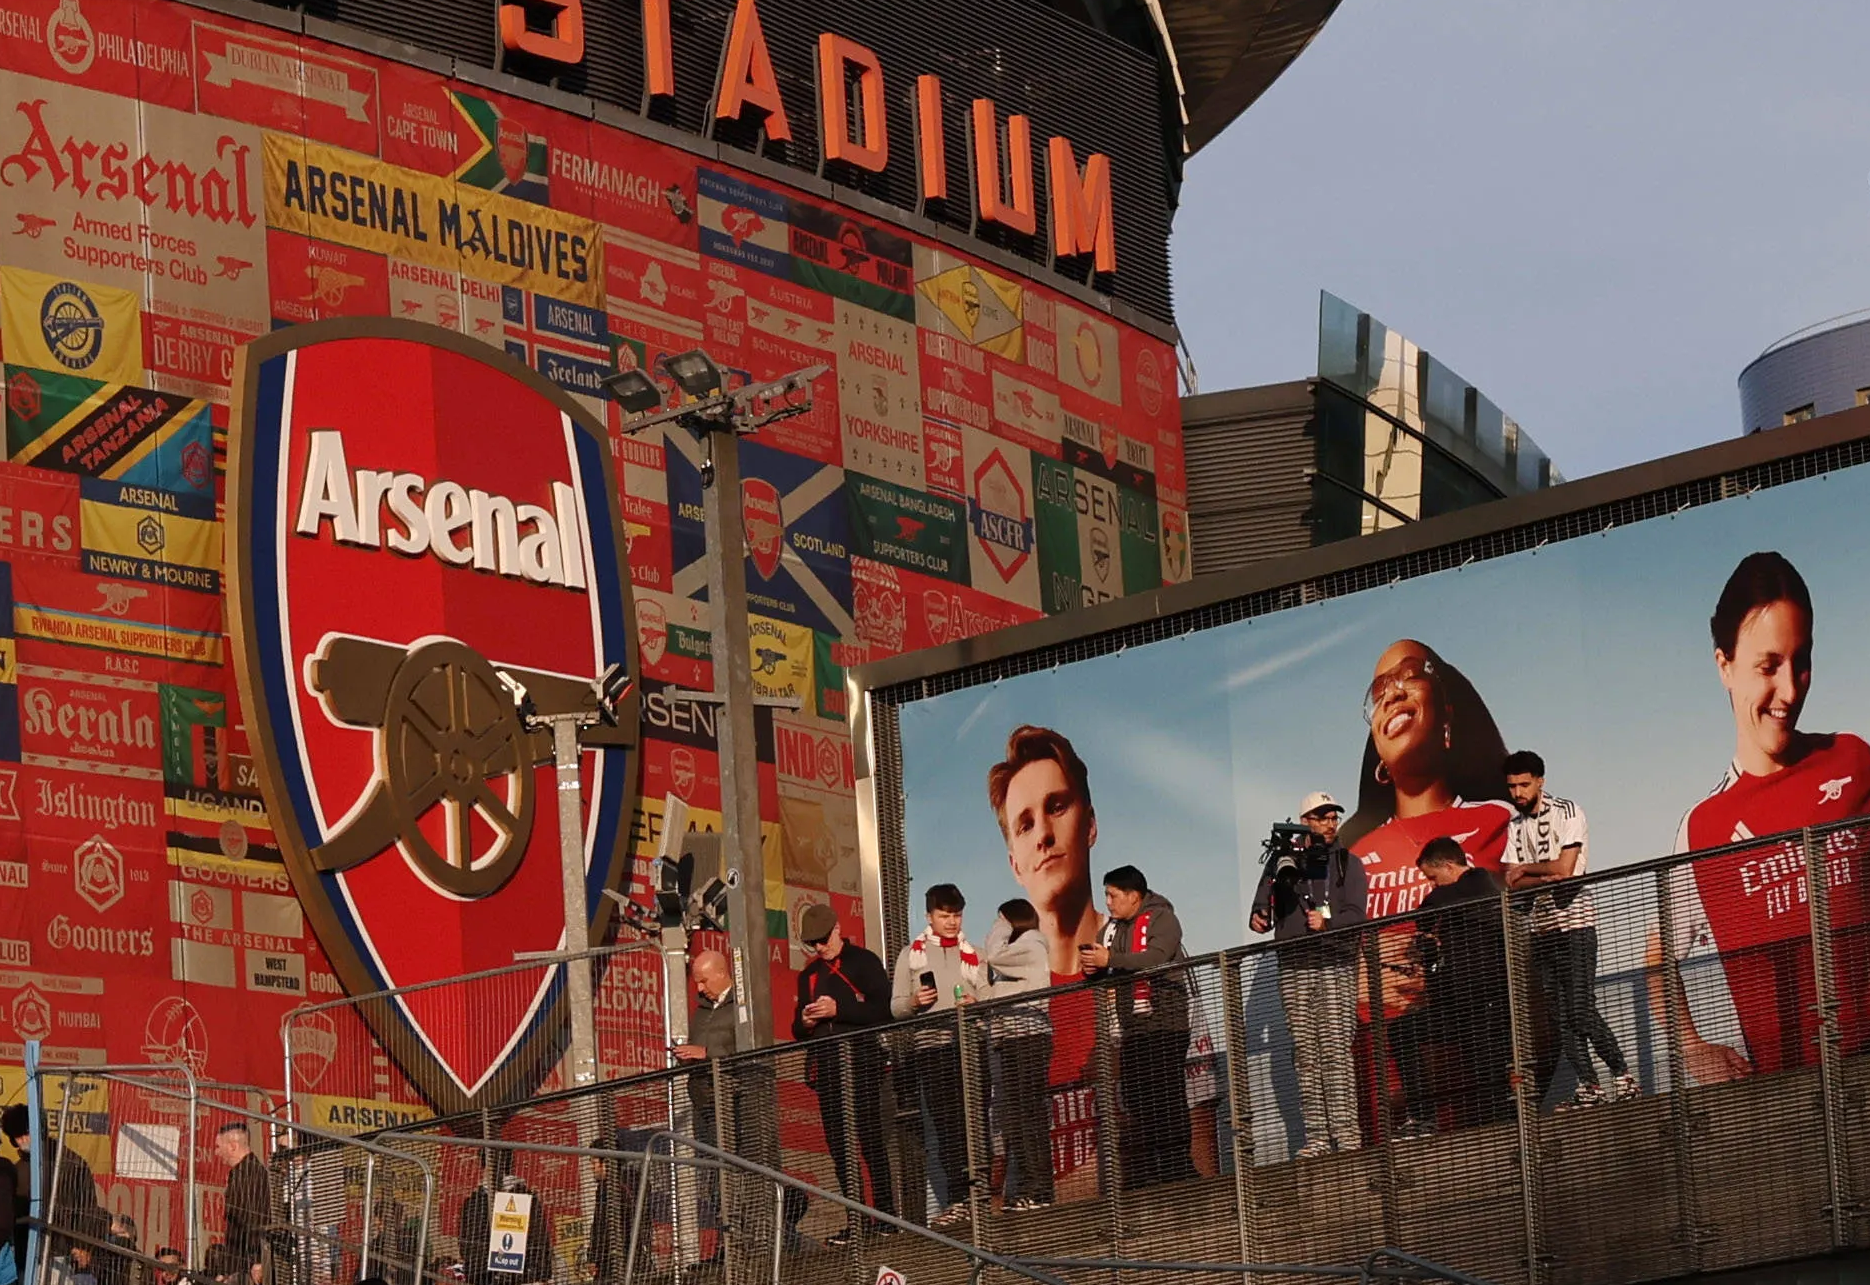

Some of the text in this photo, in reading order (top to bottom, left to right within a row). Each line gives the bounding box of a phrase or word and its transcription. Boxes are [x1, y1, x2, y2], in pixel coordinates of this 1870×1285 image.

[97, 27, 189, 77] PHILADELPHIA
[231, 46, 346, 93] DUBLIN ARSENAL
[402, 102, 440, 125] ARSENAL
[387, 116, 459, 154] CAPE TOWN
[0, 98, 257, 229] Arsenal
[552, 150, 659, 207] FERMANAGH
[71, 211, 198, 256] Armed Forces
[284, 159, 429, 242] ARSENAL
[439, 199, 588, 283] MALDIVES
[63, 237, 208, 286] Supporters Club
[390, 263, 501, 302] ARSENAL DELHI
[769, 286, 812, 311] AUSTRIA
[547, 303, 596, 337] ARSENAL
[154, 333, 214, 374] DERRY
[848, 341, 909, 377] ARSENAL
[61, 393, 144, 464] ARSENAL
[79, 395, 170, 473] TANZANIA
[844, 413, 920, 455] YORKSHIRE
[119, 486, 179, 512] ARSENAL
[298, 428, 588, 590] Arsenal
[1037, 463, 1156, 542] ARSENAL
[793, 531, 847, 560] SCOTLAND
[89, 555, 212, 589] NEWRY MOURNE
[31, 616, 119, 645] RWANDA ARSENAL
[24, 687, 156, 750] Kerala
[34, 777, 156, 828] Islington
[180, 864, 290, 893] GOONERS
[1766, 881, 1791, 919] FLY
[47, 914, 155, 958] Gooners
[182, 924, 296, 953] THE ARSENAL
[58, 1010, 102, 1029] MUMBAI
